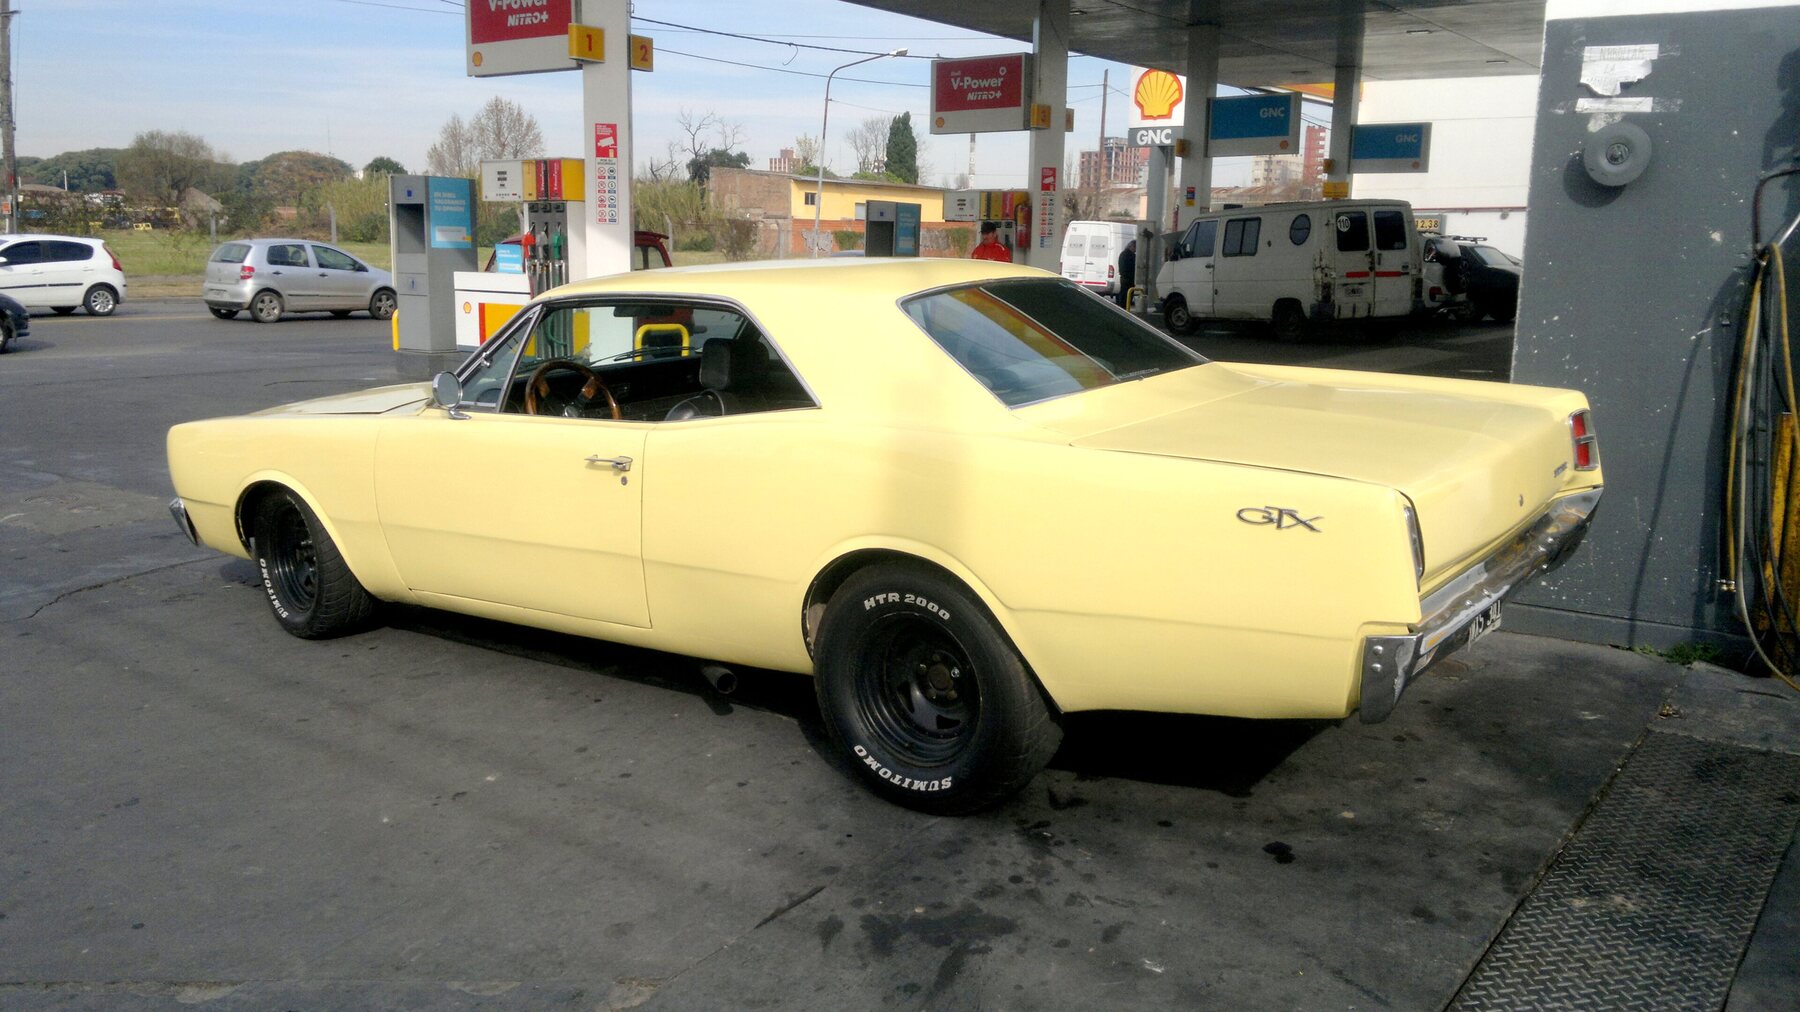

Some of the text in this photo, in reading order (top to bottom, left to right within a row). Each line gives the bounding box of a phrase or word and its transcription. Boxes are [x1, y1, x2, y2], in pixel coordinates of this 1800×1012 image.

[585, 34, 593, 52] 1
[639, 44, 649, 62] 2
[951, 76, 1004, 90] V-Power
[1259, 106, 1286, 119] GNC
[1136, 128, 1172, 146] GNC
[1395, 133, 1419, 144] GNC
[1236, 505, 1324, 533] GTX
[260, 558, 289, 618] SUMITOMO
[863, 592, 950, 621] HTR 2000
[853, 744, 952, 792] SUMITOMO
